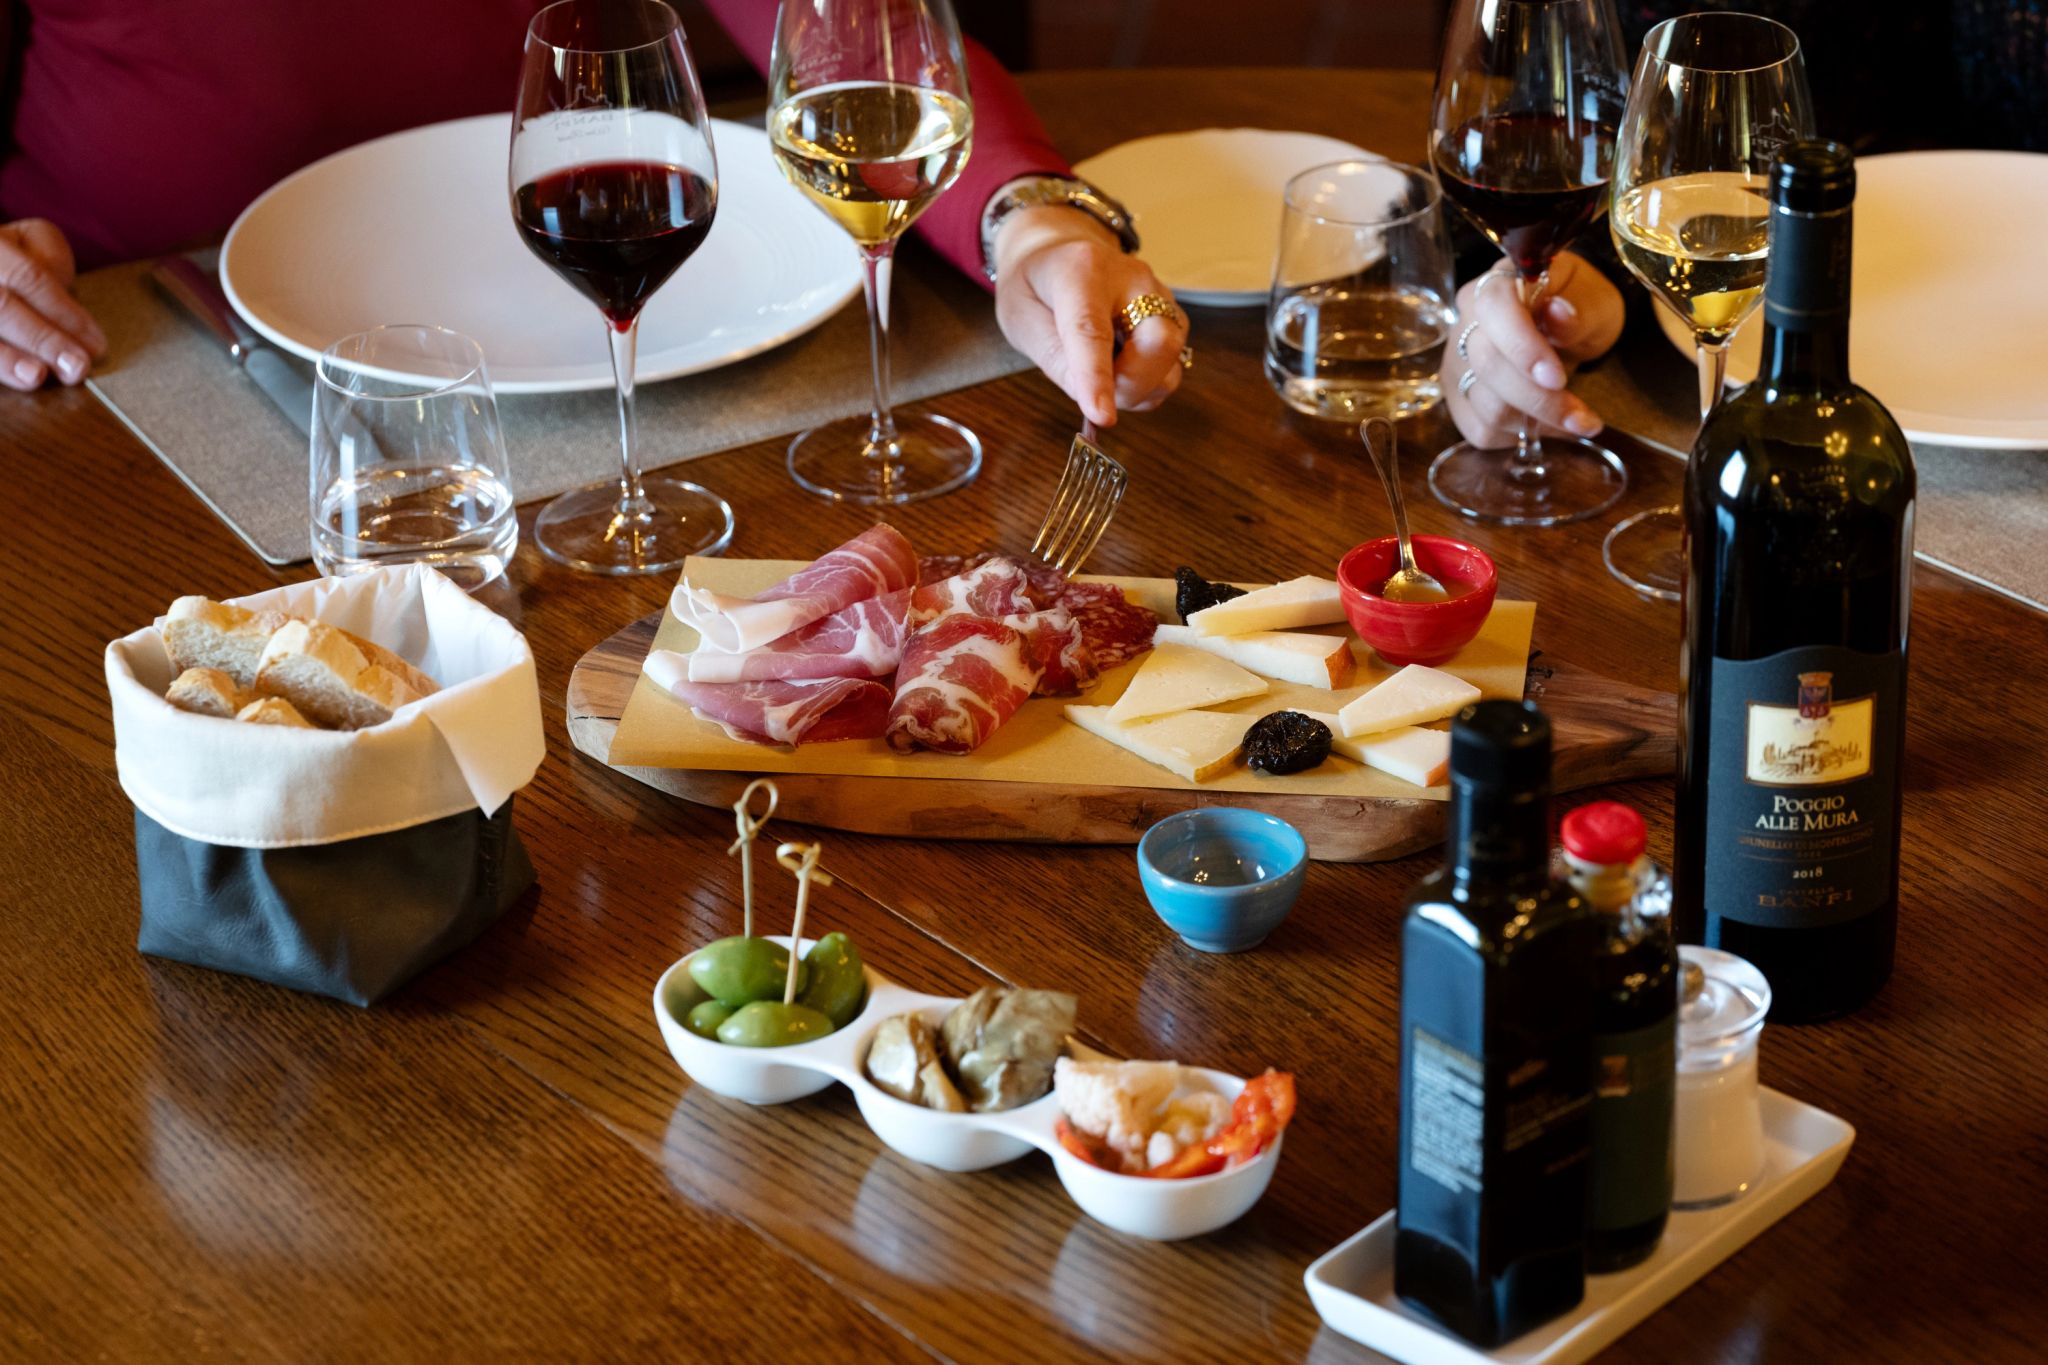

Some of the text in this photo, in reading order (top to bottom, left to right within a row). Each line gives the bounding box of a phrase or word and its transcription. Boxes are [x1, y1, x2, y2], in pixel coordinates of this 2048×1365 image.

[1773, 795, 1845, 814] POGGIO
[1755, 810, 1859, 832] ALLE MURA
[1792, 865, 1824, 879] 2018
